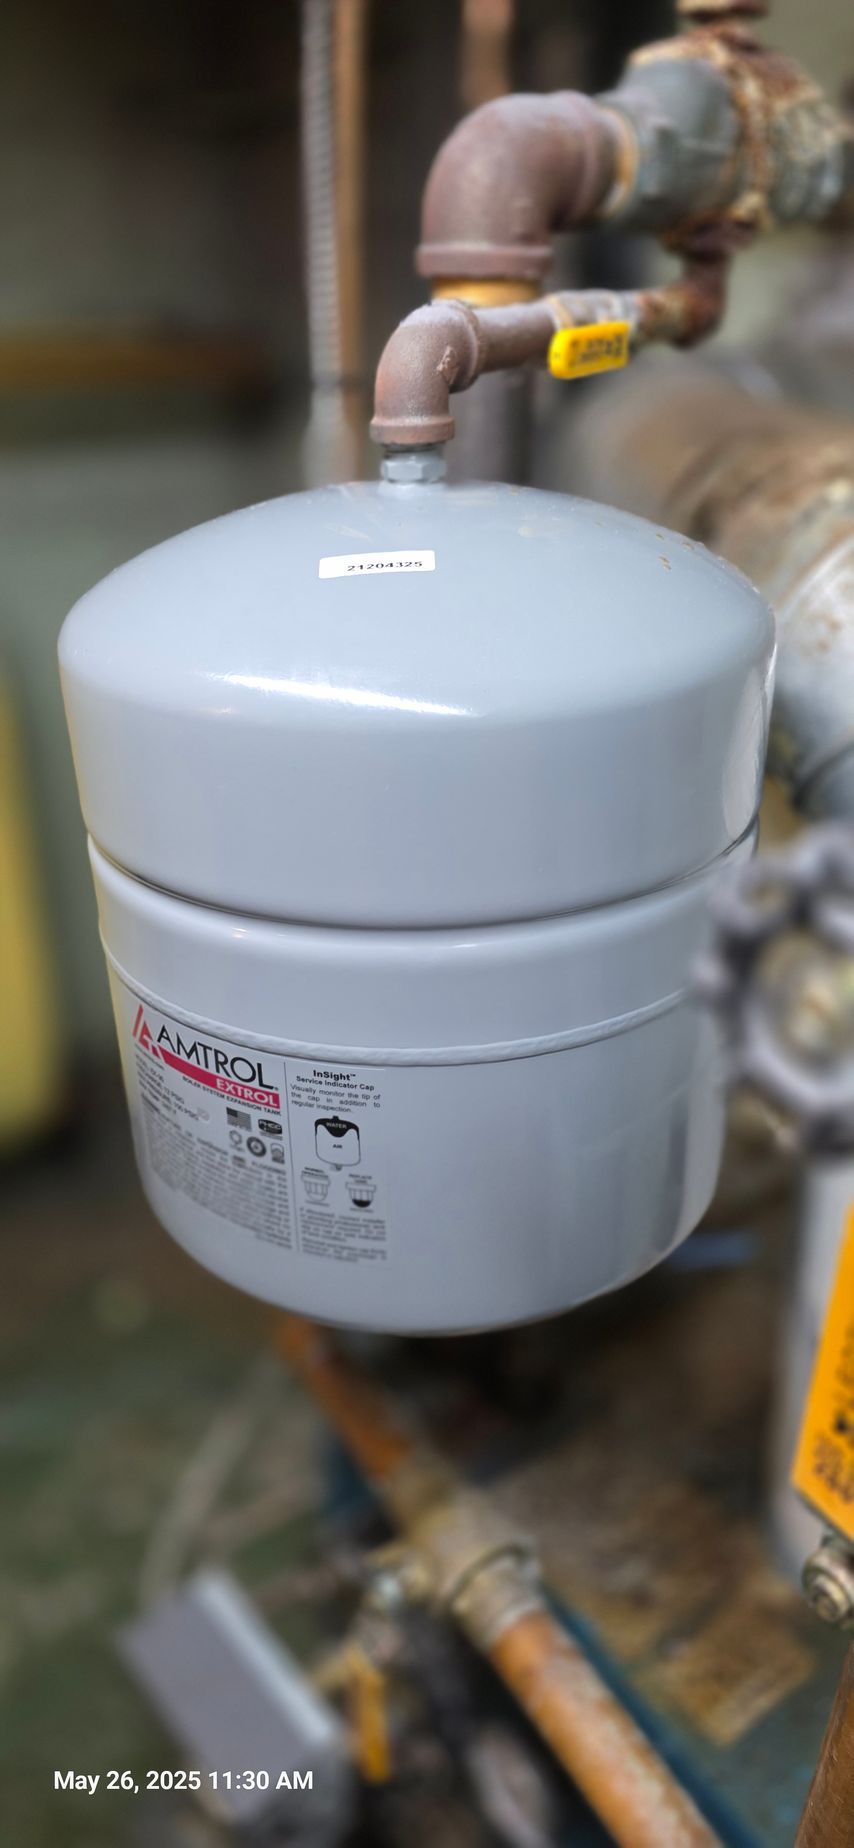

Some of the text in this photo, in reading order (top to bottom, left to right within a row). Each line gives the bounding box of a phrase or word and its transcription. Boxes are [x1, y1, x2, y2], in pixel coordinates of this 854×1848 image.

[347, 561, 423, 572] 21204325
[296, 1076, 323, 1085] Service
[324, 1080, 358, 1090] Indicator
[216, 1078, 278, 1107] EXTROL
[290, 1084, 317, 1095] Visually
[319, 1089, 345, 1097] monitor
[202, 1086, 225, 1101] SYSTEM
[226, 1096, 262, 1112] EXPANSION
[263, 1107, 281, 1117] TANK
[291, 1100, 315, 1109] regular
[339, 1099, 367, 1107] addition
